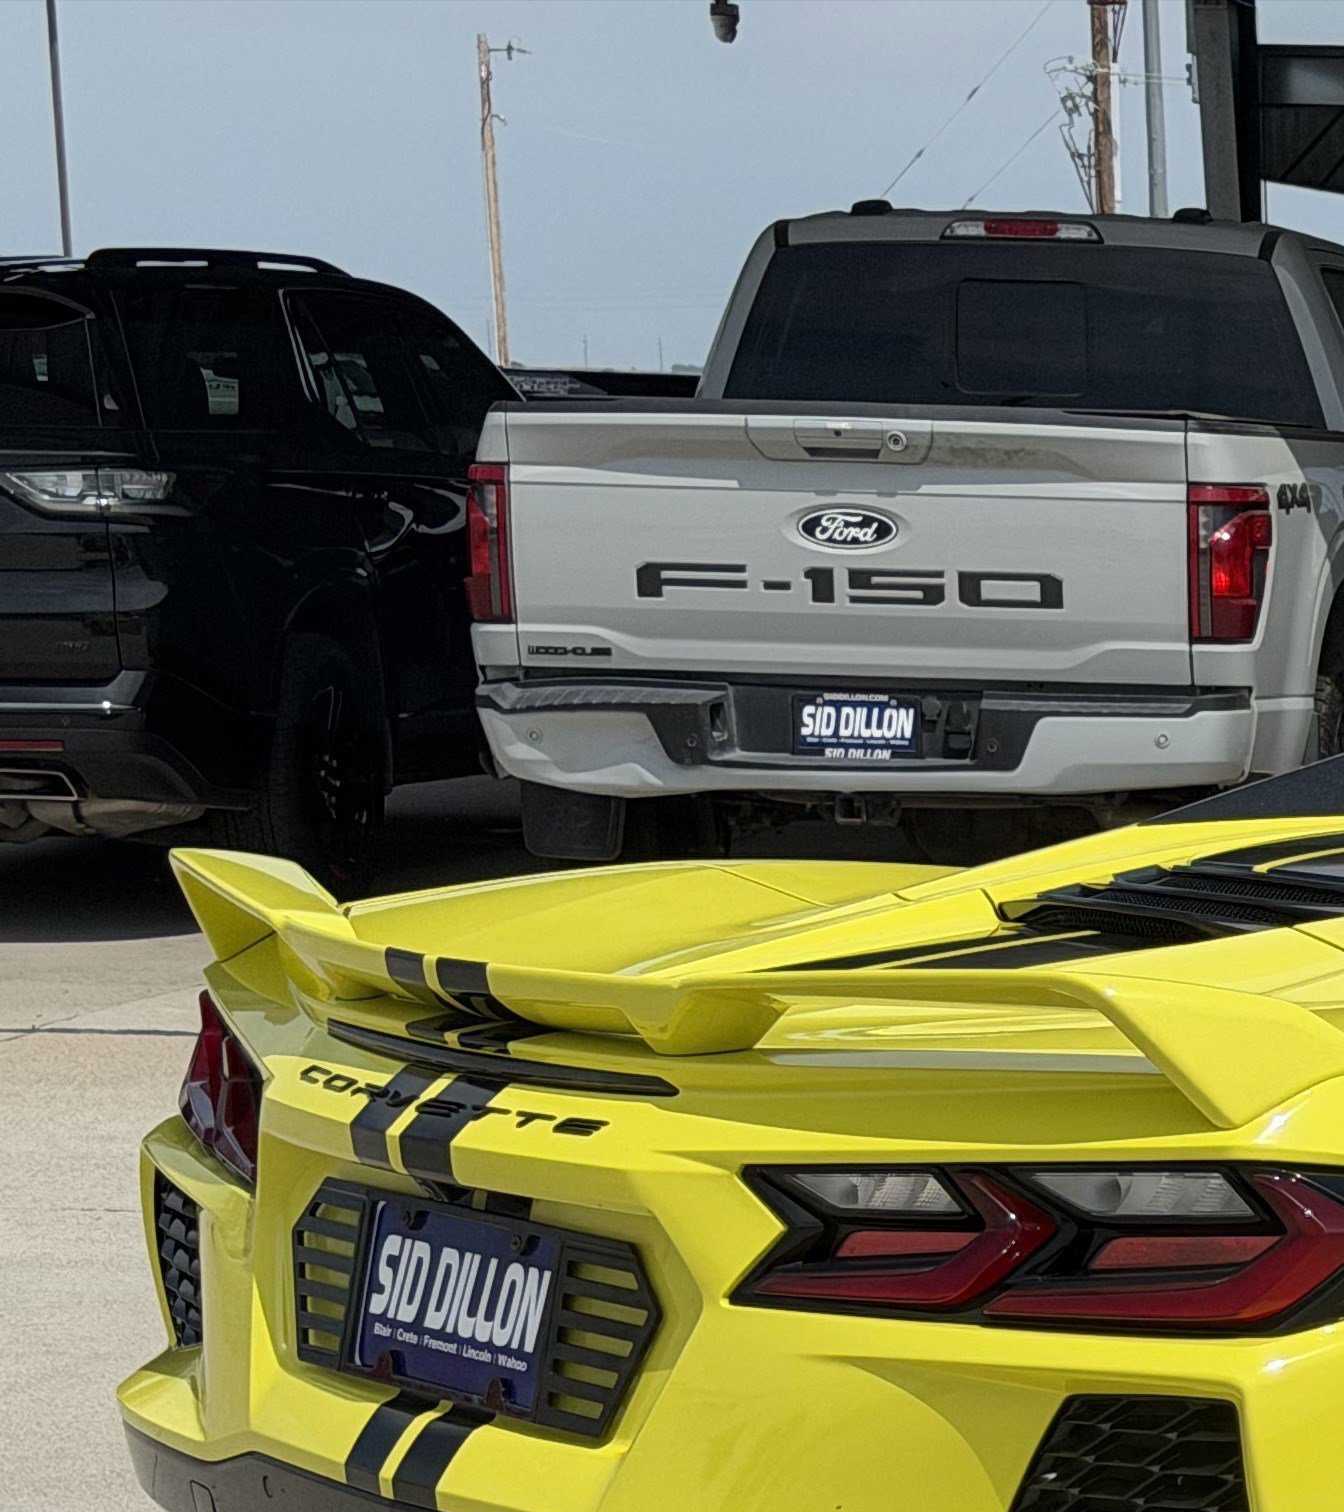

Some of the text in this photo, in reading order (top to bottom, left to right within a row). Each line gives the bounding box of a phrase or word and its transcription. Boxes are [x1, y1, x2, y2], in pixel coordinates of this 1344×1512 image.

[815, 513, 879, 542] Ford
[635, 562, 1065, 609] F-150
[800, 705, 915, 739] SID DILLON
[300, 1064, 611, 1137] CORVETTE
[368, 1234, 553, 1354] SID DILLON
[497, 1353, 528, 1372] Wahoo
